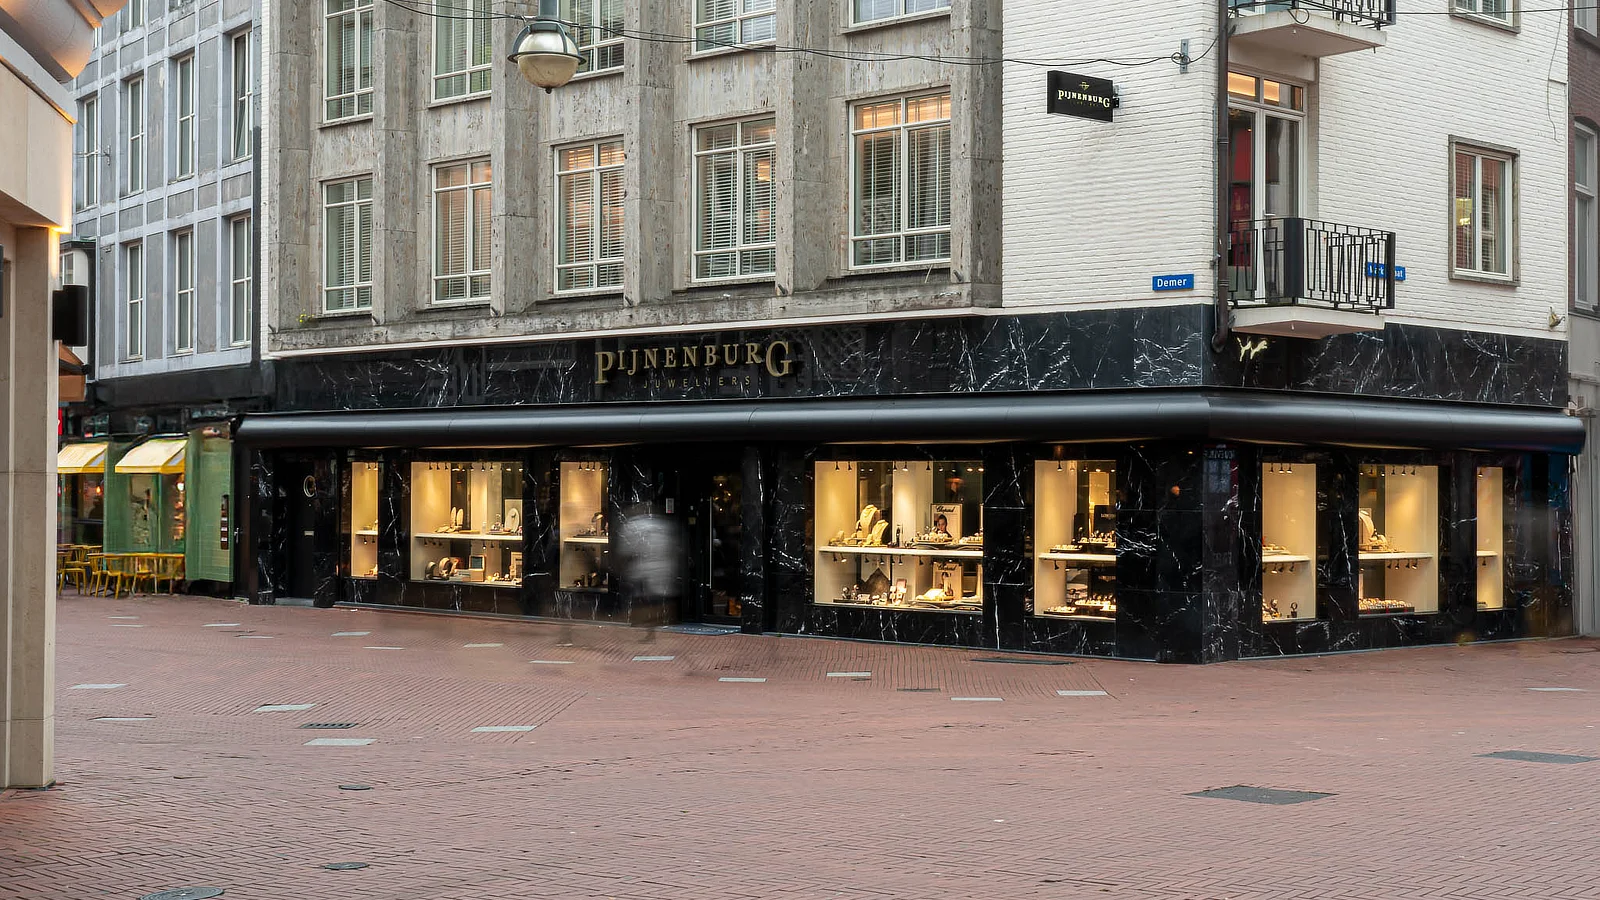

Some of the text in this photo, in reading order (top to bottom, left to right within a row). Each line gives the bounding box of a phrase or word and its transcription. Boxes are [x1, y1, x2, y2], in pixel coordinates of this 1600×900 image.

[1058, 89, 1110, 108] PIJNENBURG
[1157, 278, 1187, 288] Demer
[595, 341, 792, 384] PIJNENBURG
[643, 376, 750, 389] JUWELIERS
